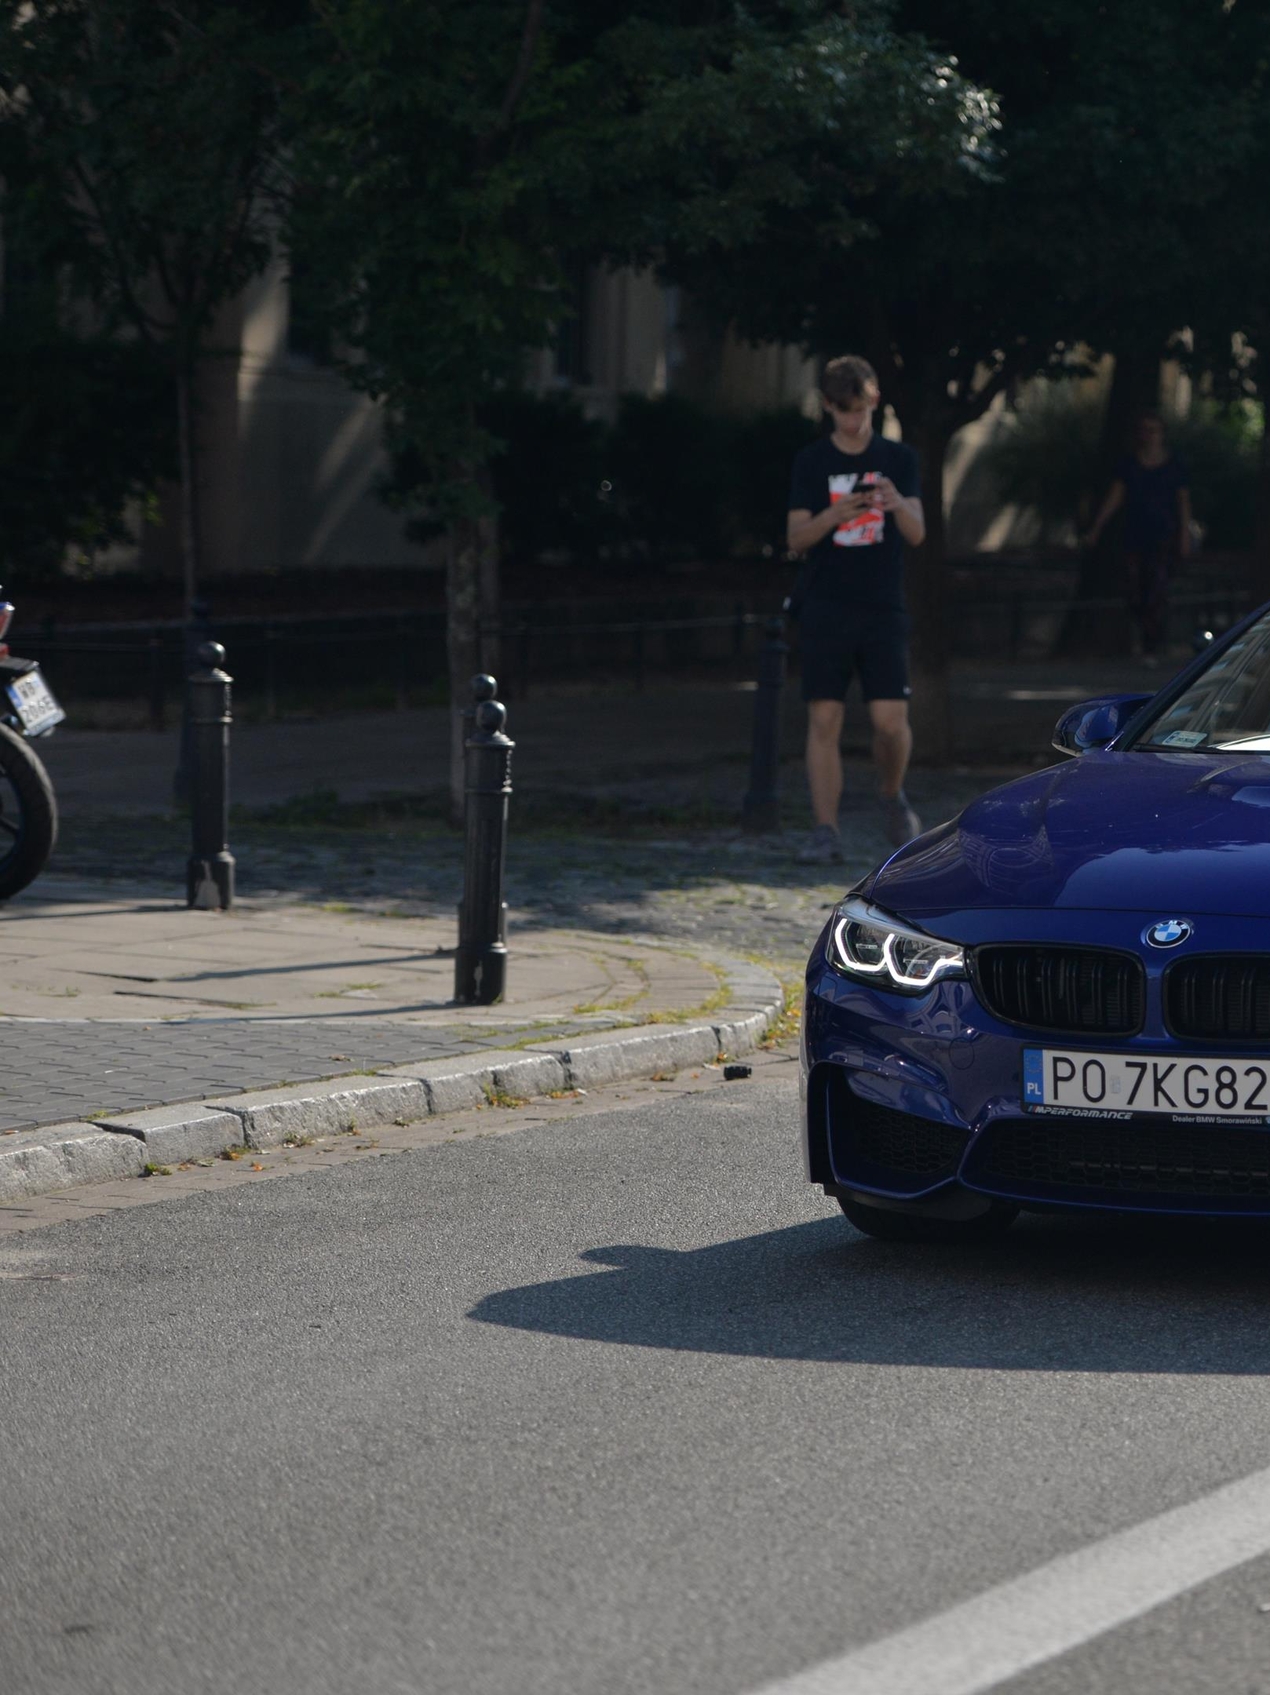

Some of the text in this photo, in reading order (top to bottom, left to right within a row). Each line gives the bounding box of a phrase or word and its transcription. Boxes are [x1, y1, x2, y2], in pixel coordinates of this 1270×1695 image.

[1027, 1082, 1041, 1095] PL
[1052, 1056, 1268, 1110] PO 7KG82
[1172, 1114, 1195, 1123] Dealer
[1196, 1116, 1215, 1124] BMW
